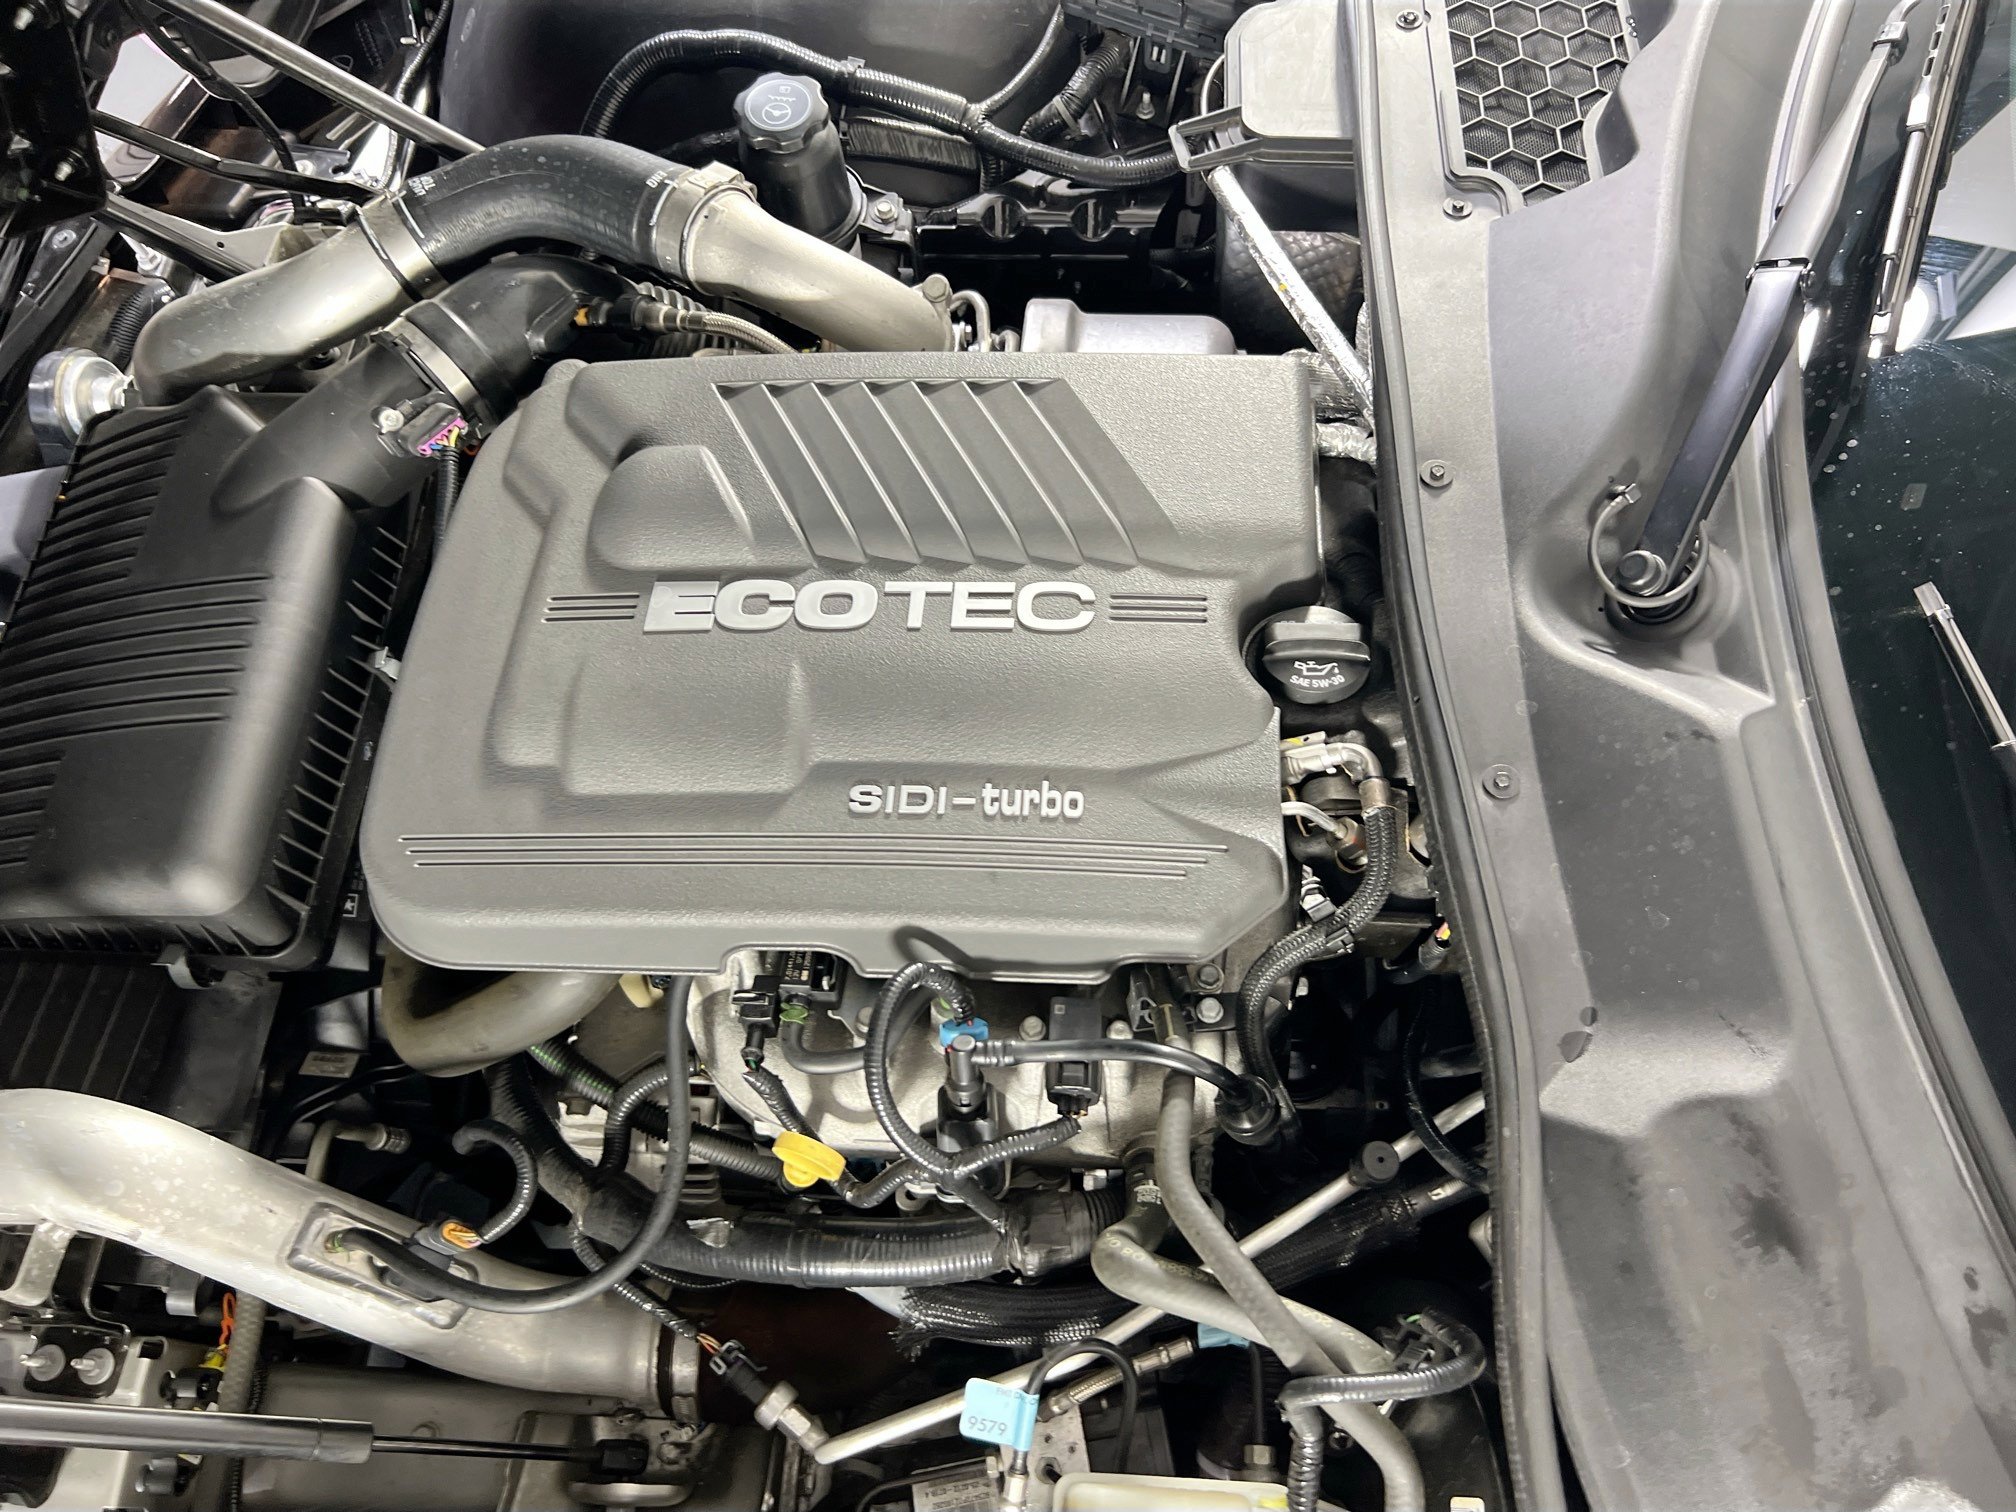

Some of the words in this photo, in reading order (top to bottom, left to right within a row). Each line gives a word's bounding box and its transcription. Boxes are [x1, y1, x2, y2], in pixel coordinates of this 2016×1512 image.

[643, 579, 1096, 632] ECOTEC
[1290, 675, 1310, 687] SAE
[1311, 675, 1345, 688] 5W-30
[848, 780, 1085, 819] SIDI-turbo
[968, 1416, 1007, 1436] 9579
